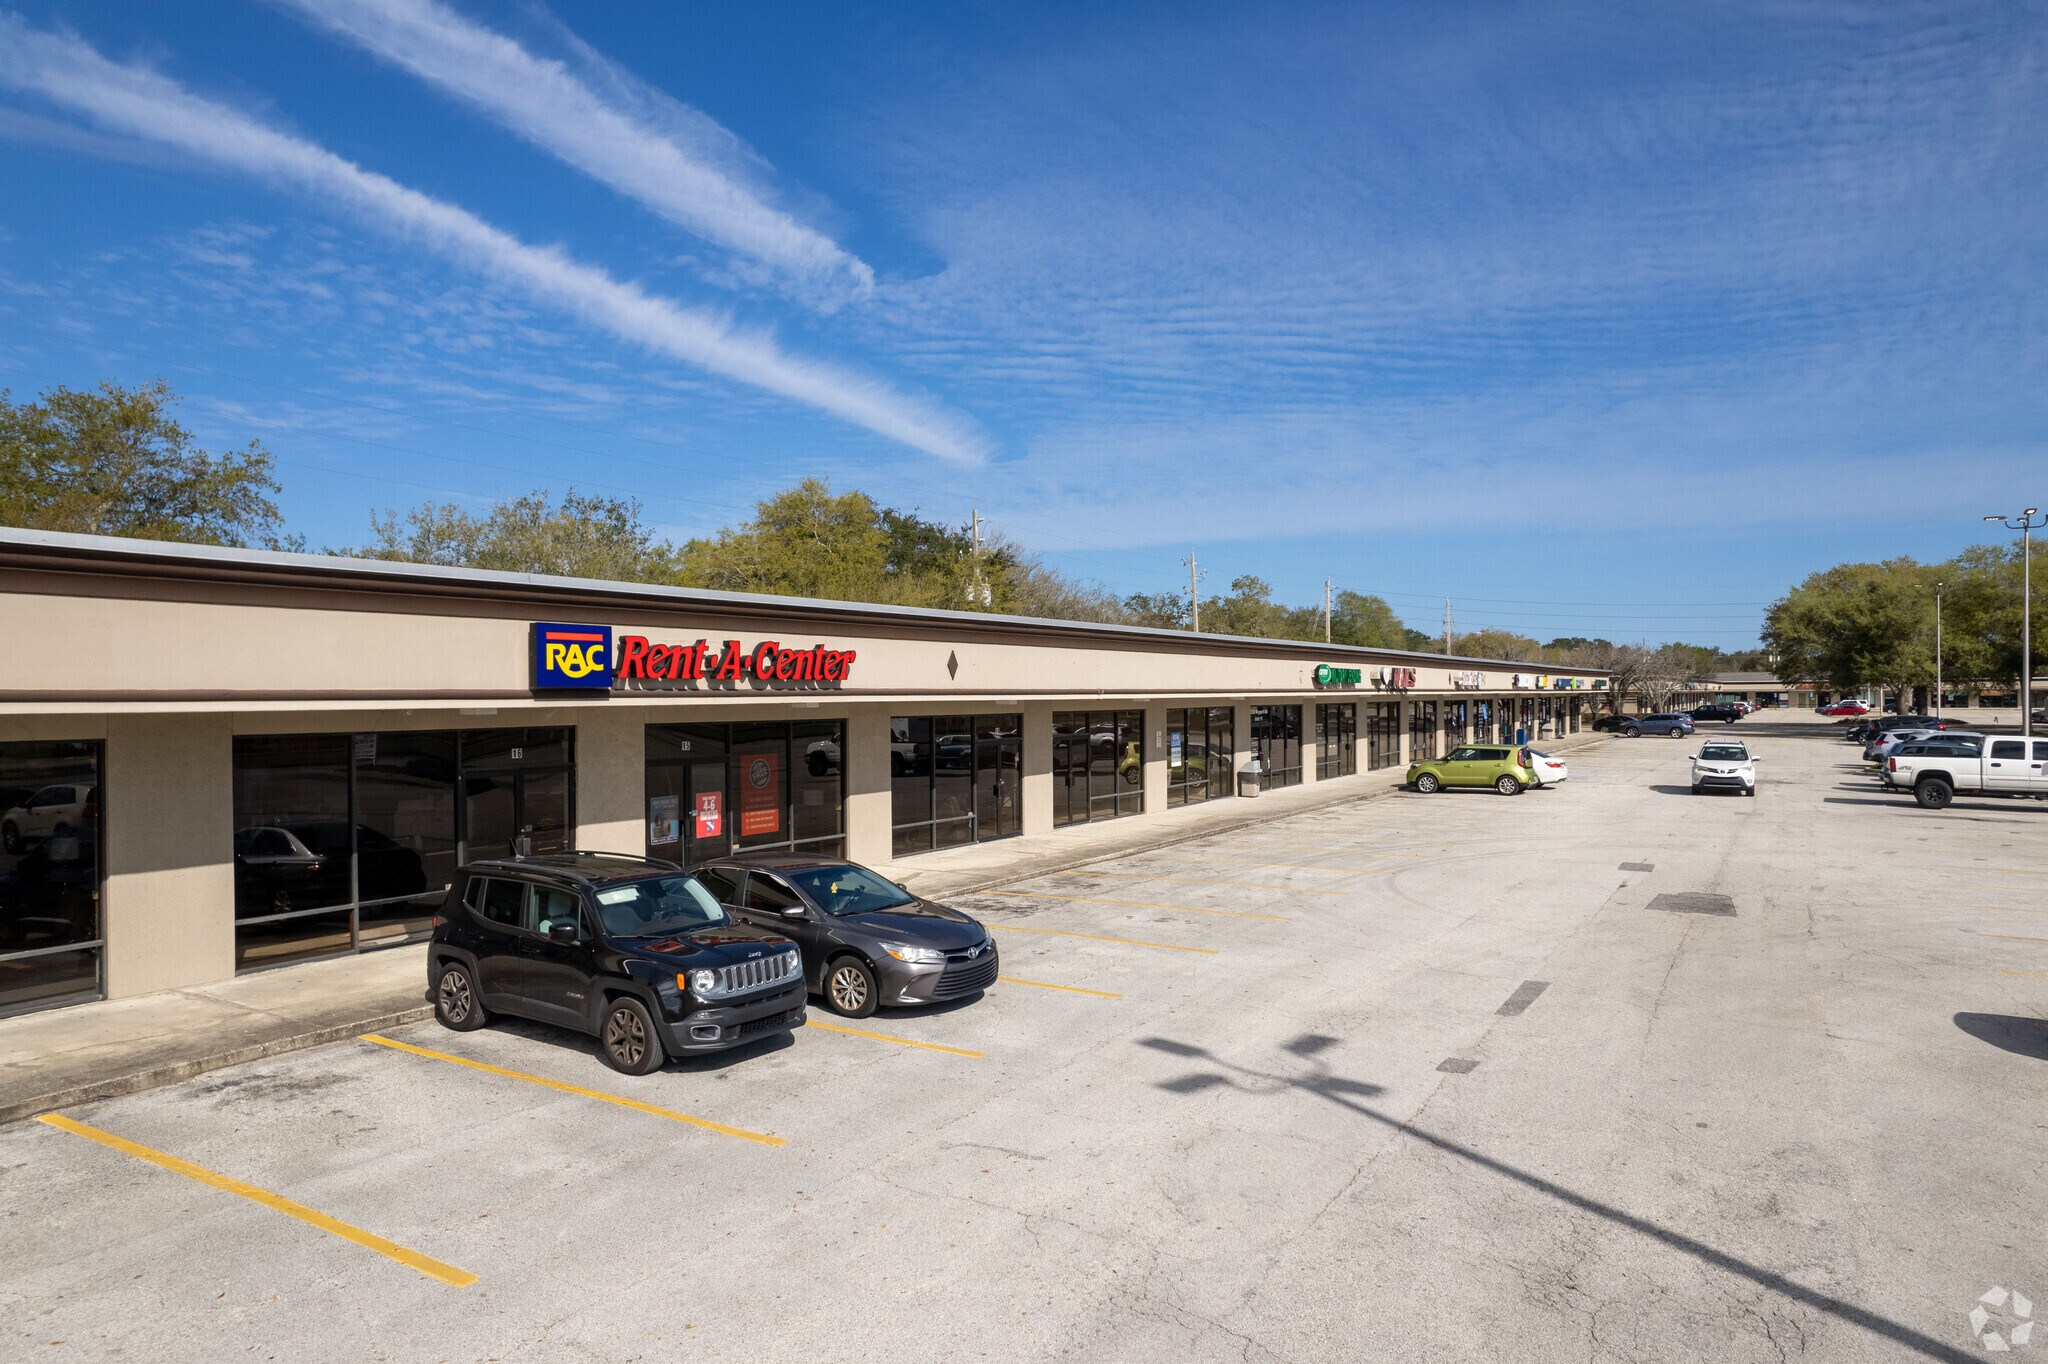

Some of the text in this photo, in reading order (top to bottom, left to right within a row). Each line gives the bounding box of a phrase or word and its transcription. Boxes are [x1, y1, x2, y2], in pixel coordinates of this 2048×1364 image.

[546, 643, 604, 678] RAC
[682, 741, 690, 750] 15
[512, 748, 522, 758] 16
[752, 767, 768, 781] FREE
[703, 800, 715, 810] 4-6
